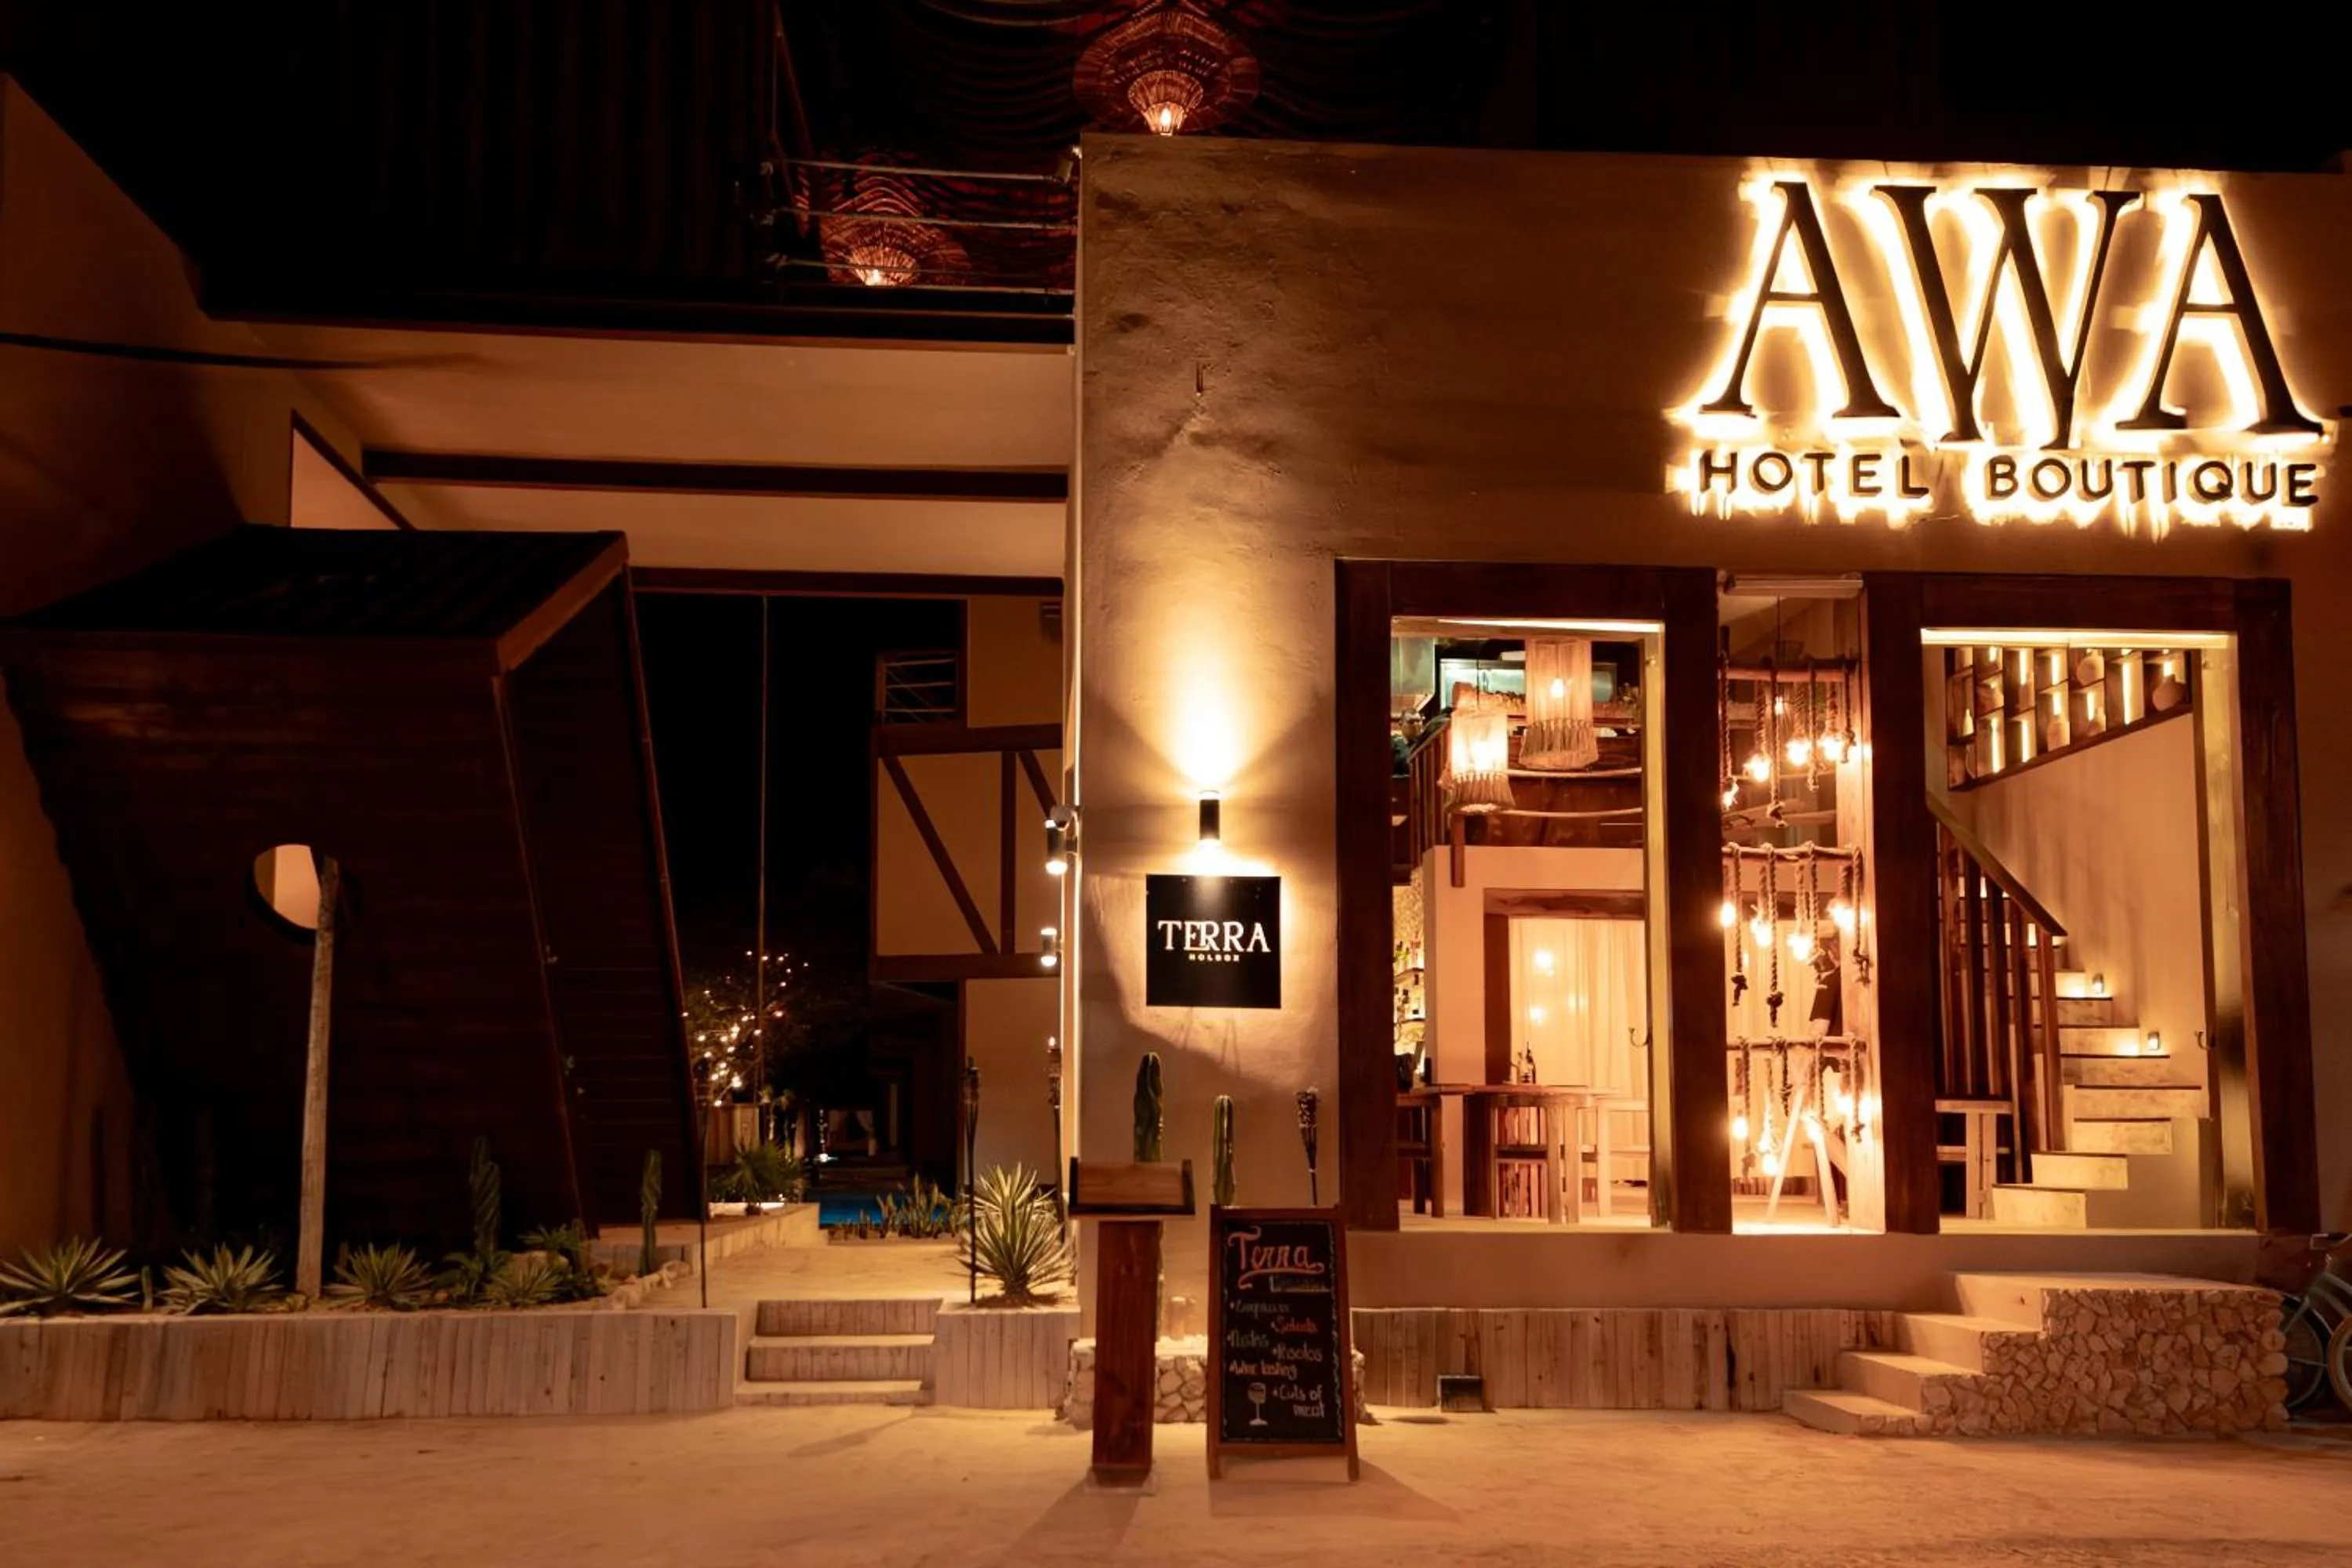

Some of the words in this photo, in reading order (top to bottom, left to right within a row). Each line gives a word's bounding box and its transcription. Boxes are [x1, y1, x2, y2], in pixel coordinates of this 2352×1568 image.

[1699, 181, 2324, 449] AWA
[1700, 450, 1929, 496] HOTEL
[1985, 458, 2319, 506] BOUTIQUE
[1158, 920, 1271, 952] TERRA
[1227, 1225, 1325, 1275] Terra
[1308, 1384, 1323, 1401] of
